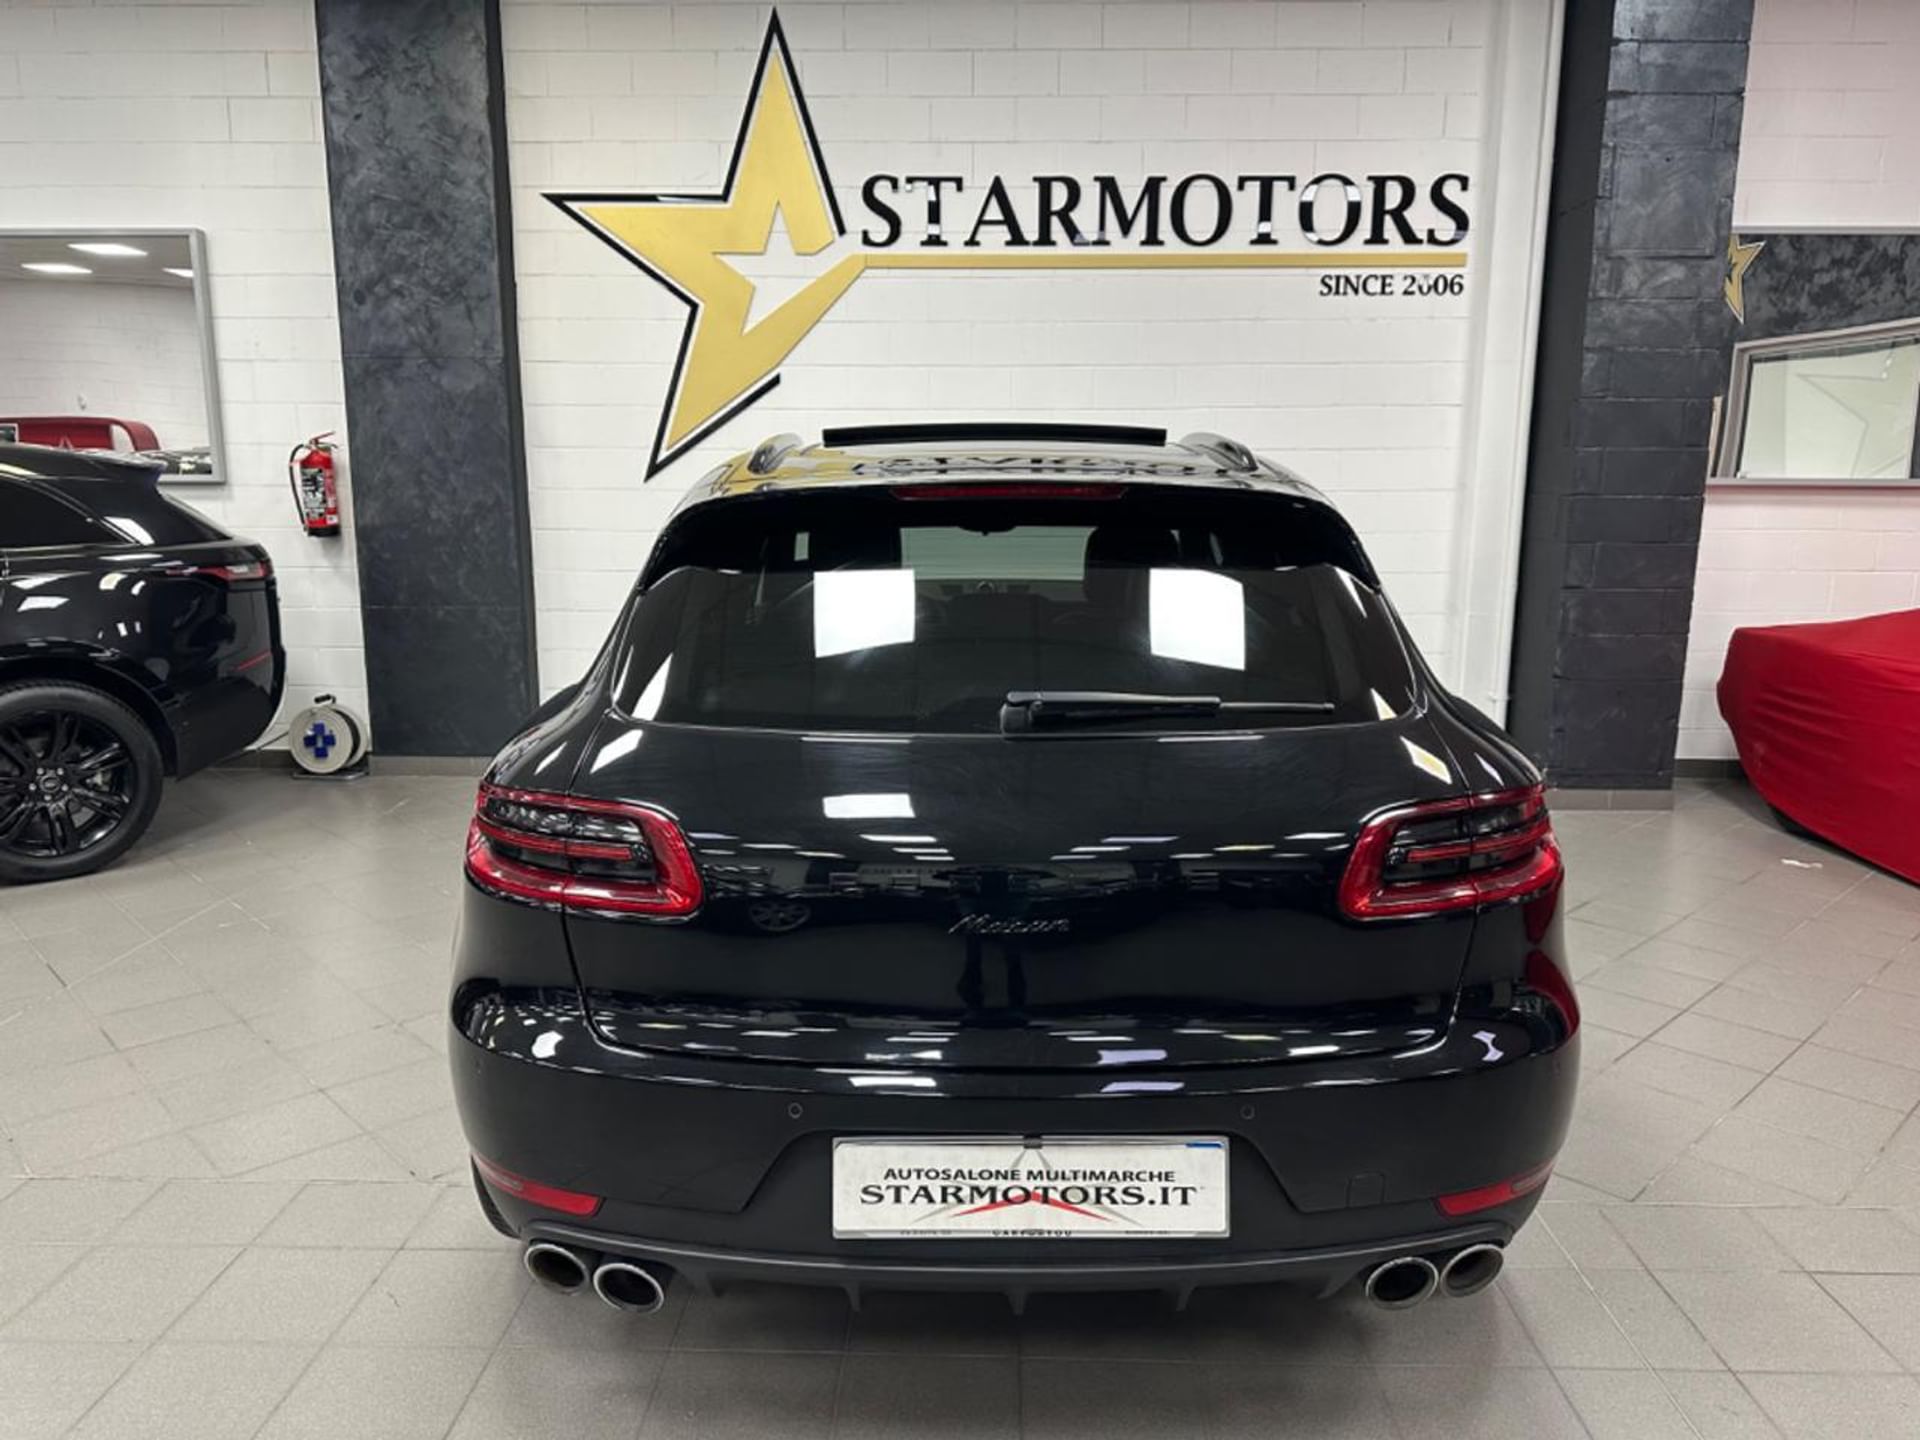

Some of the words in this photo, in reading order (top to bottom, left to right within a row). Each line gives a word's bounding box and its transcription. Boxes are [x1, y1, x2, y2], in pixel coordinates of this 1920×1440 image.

[861, 173, 1470, 248] STARMOTORS
[1319, 274, 1394, 296] SINCE
[1402, 274, 1464, 296] 2006
[884, 1168, 1020, 1181] AUTOSALONE
[1026, 1169, 1175, 1182] MULTIMARCHE
[860, 1184, 1197, 1206] STARMOTORS.IT
